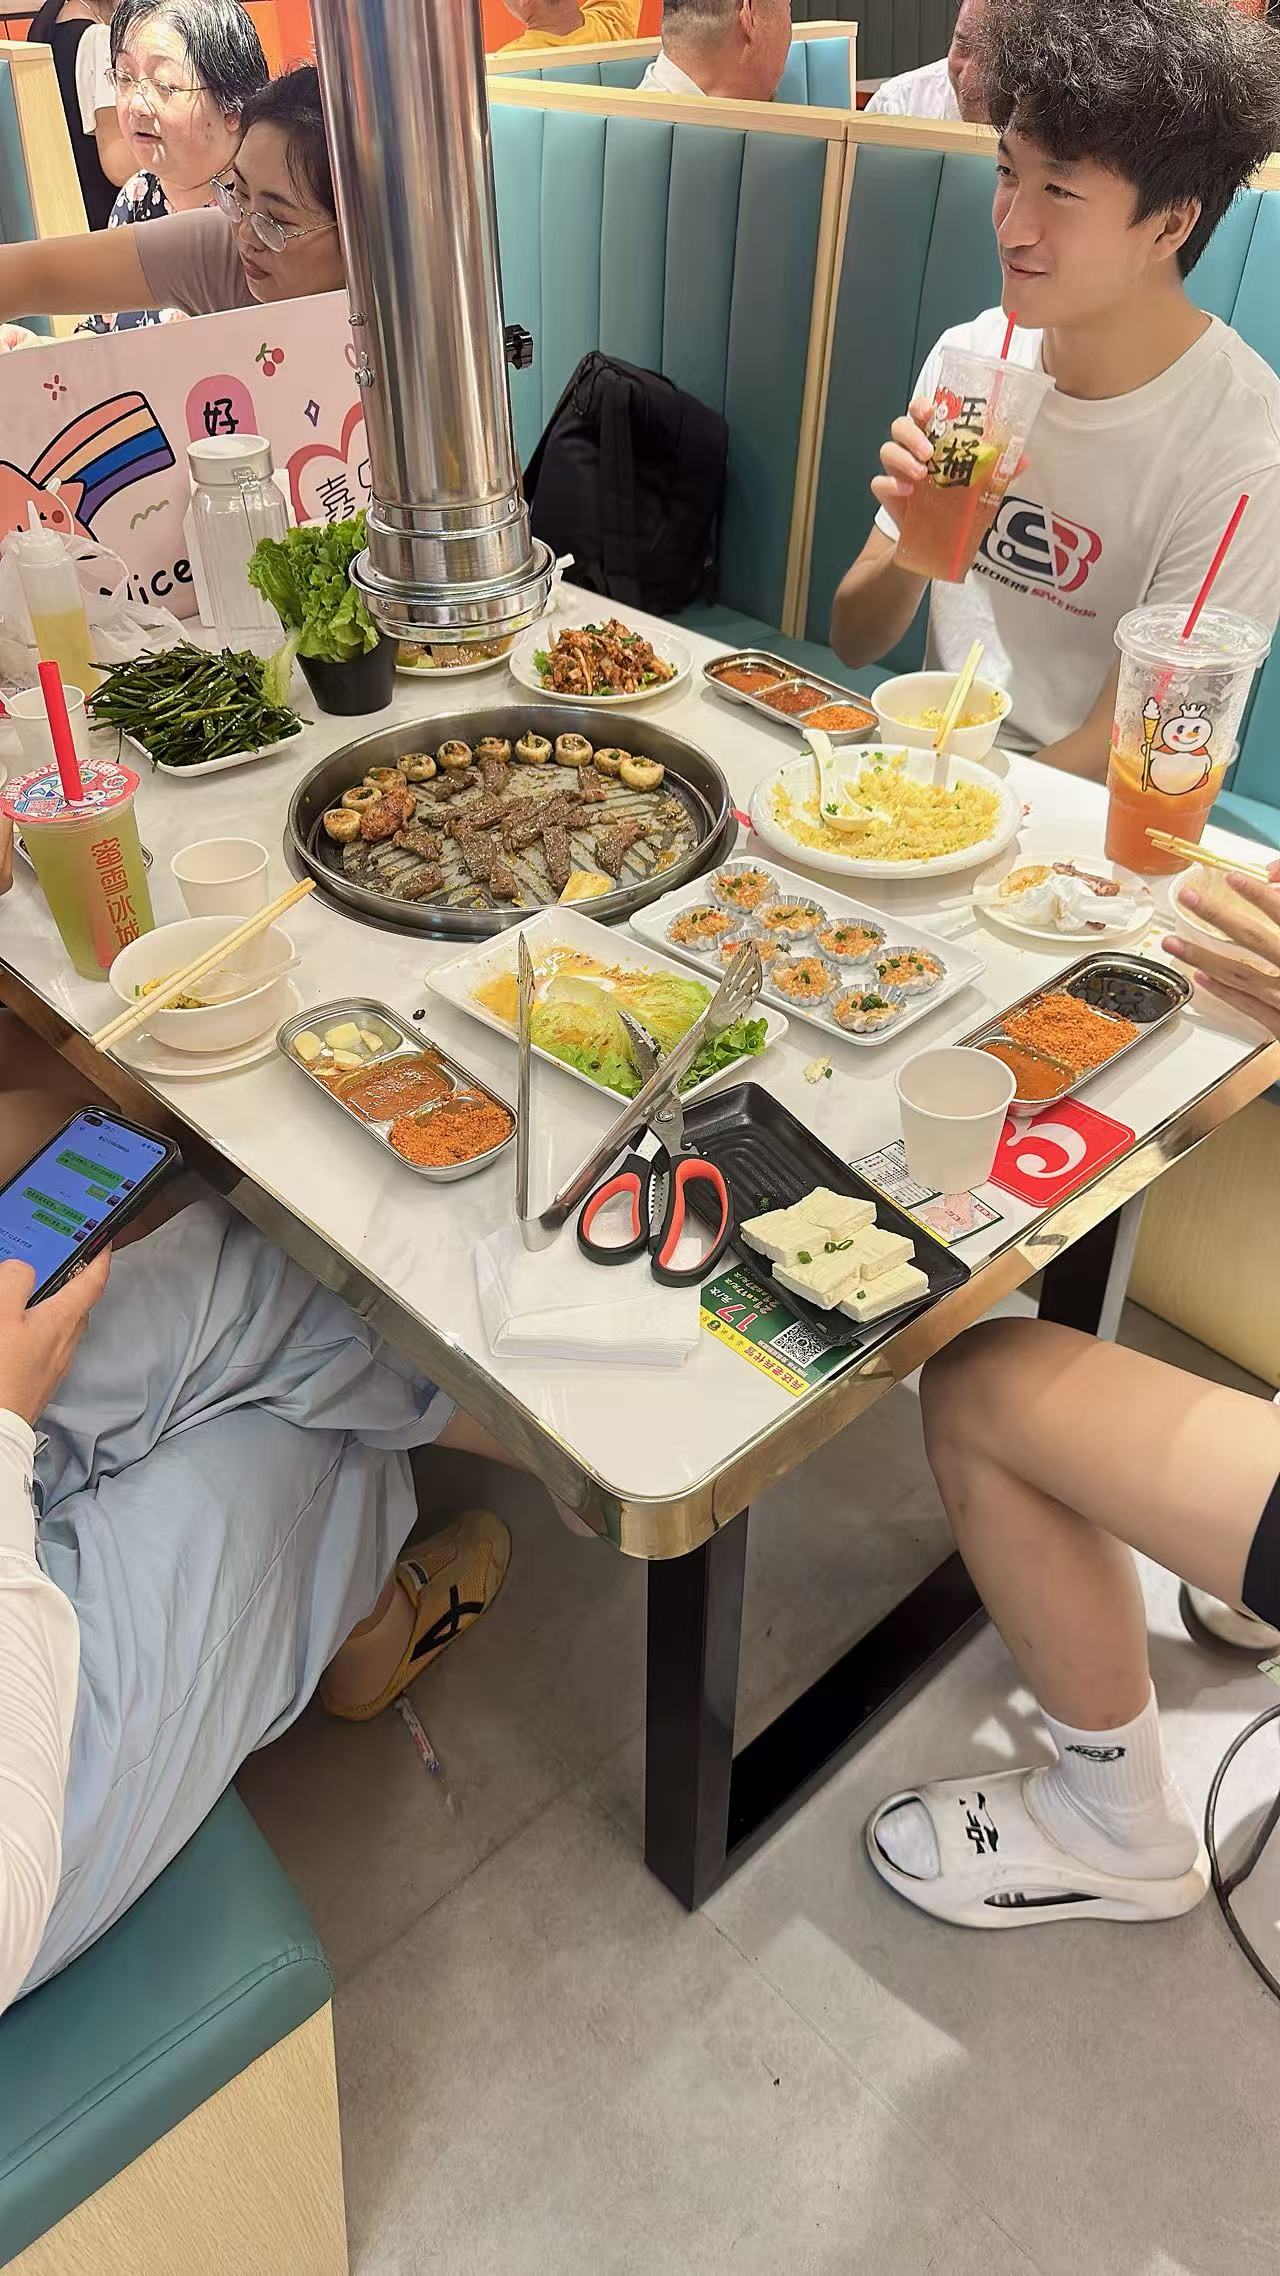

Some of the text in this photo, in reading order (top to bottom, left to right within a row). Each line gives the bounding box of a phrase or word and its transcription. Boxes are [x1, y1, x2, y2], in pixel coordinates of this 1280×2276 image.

[971, 562, 1029, 593] KECHERS
[91, 836, 141, 949] 蜜雪冰城
